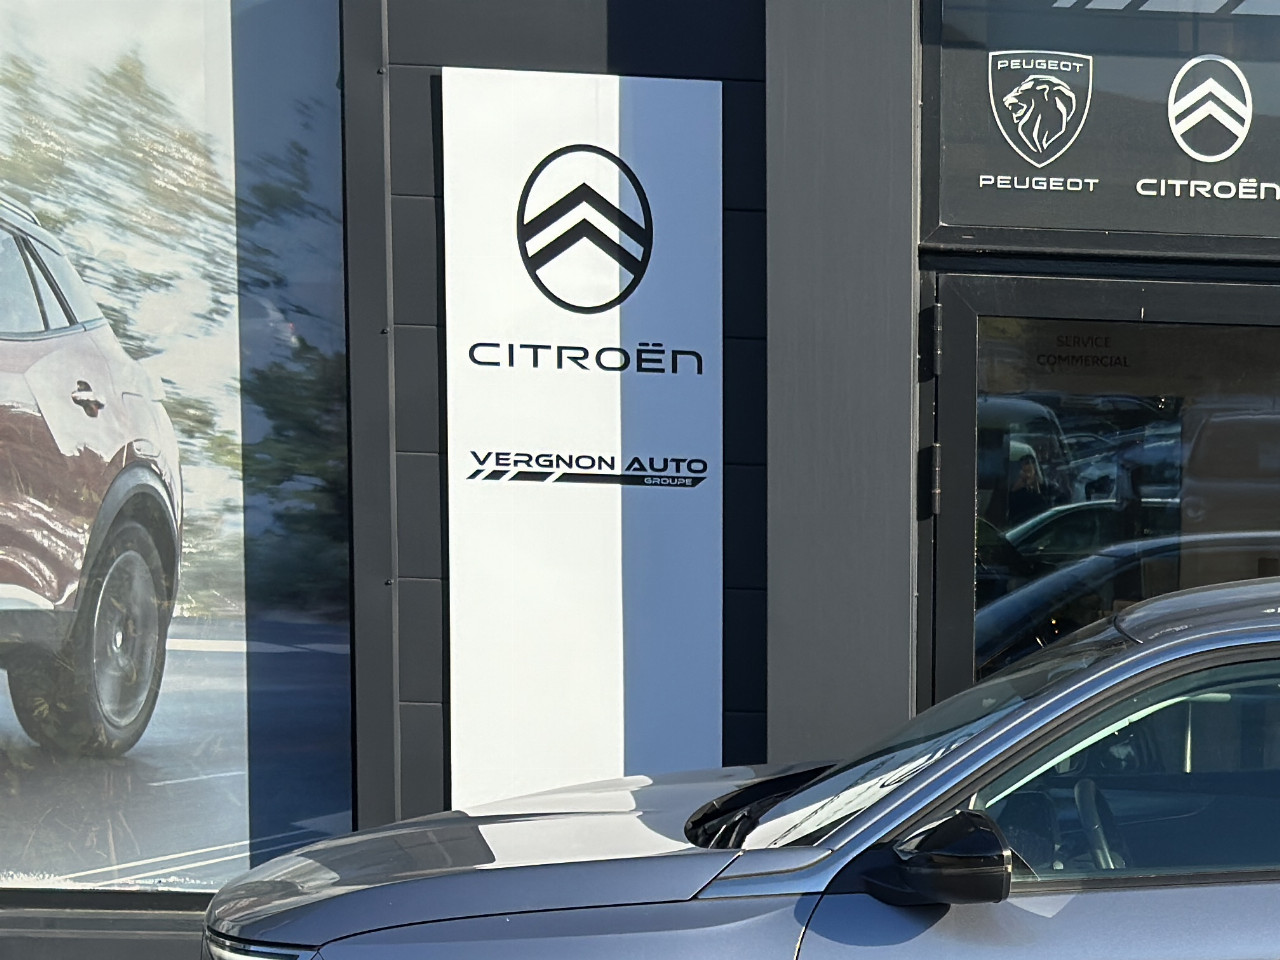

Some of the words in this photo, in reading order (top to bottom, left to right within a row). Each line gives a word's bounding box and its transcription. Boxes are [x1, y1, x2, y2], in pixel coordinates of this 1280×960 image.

[997, 59, 1084, 73] PEUGEOT
[979, 174, 1099, 191] PEUGEOT
[1136, 177, 1280, 201] CITROËN
[1056, 335, 1111, 348] SERVICE
[468, 342, 703, 375] CITROËN
[1036, 354, 1129, 367] COMMERCIAL
[470, 451, 615, 471] VERGNON
[624, 457, 707, 473] AUTO
[644, 477, 692, 486] GROUPE
